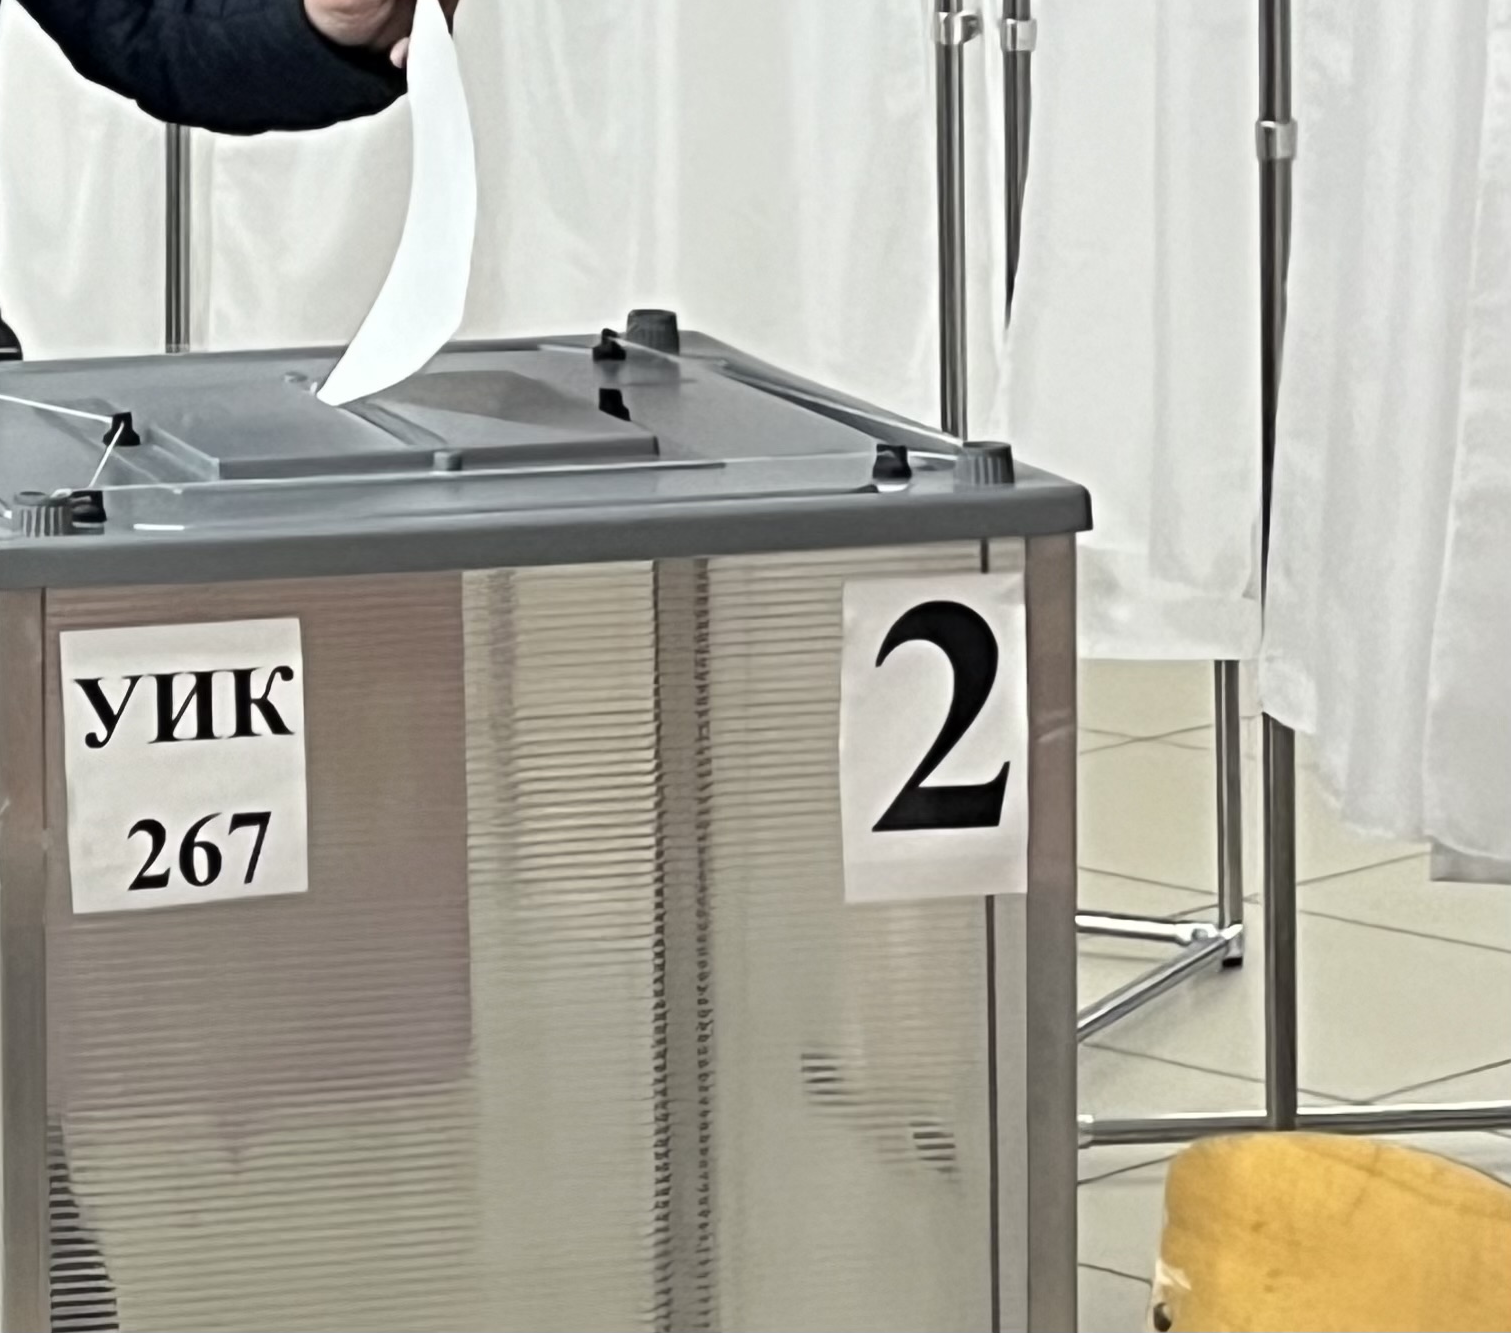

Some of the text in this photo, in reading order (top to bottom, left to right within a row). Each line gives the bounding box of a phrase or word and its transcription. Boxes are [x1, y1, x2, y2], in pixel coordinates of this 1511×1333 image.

[73, 665, 296, 749] УИК
[871, 600, 1011, 833] 2
[126, 811, 273, 892] 267
